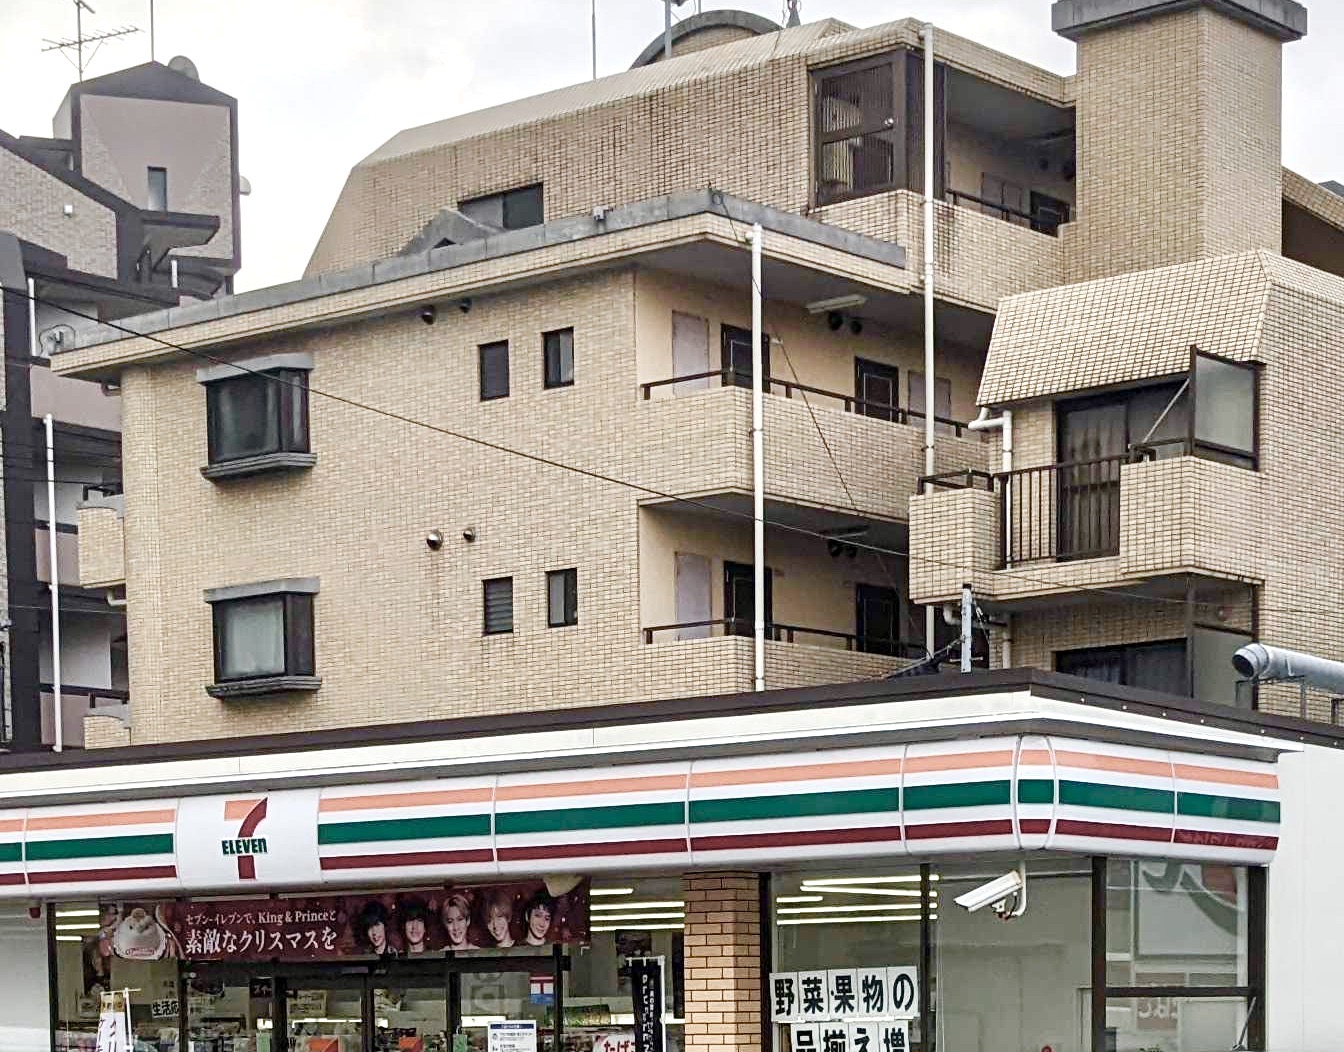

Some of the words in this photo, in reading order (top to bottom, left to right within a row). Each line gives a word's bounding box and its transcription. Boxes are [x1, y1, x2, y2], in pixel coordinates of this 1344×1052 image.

[258, 911, 284, 926] King
[285, 911, 294, 923] &
[186, 926, 337, 954] 素敵なクリスマスを
[774, 973, 915, 1016] 野菜・果物の
